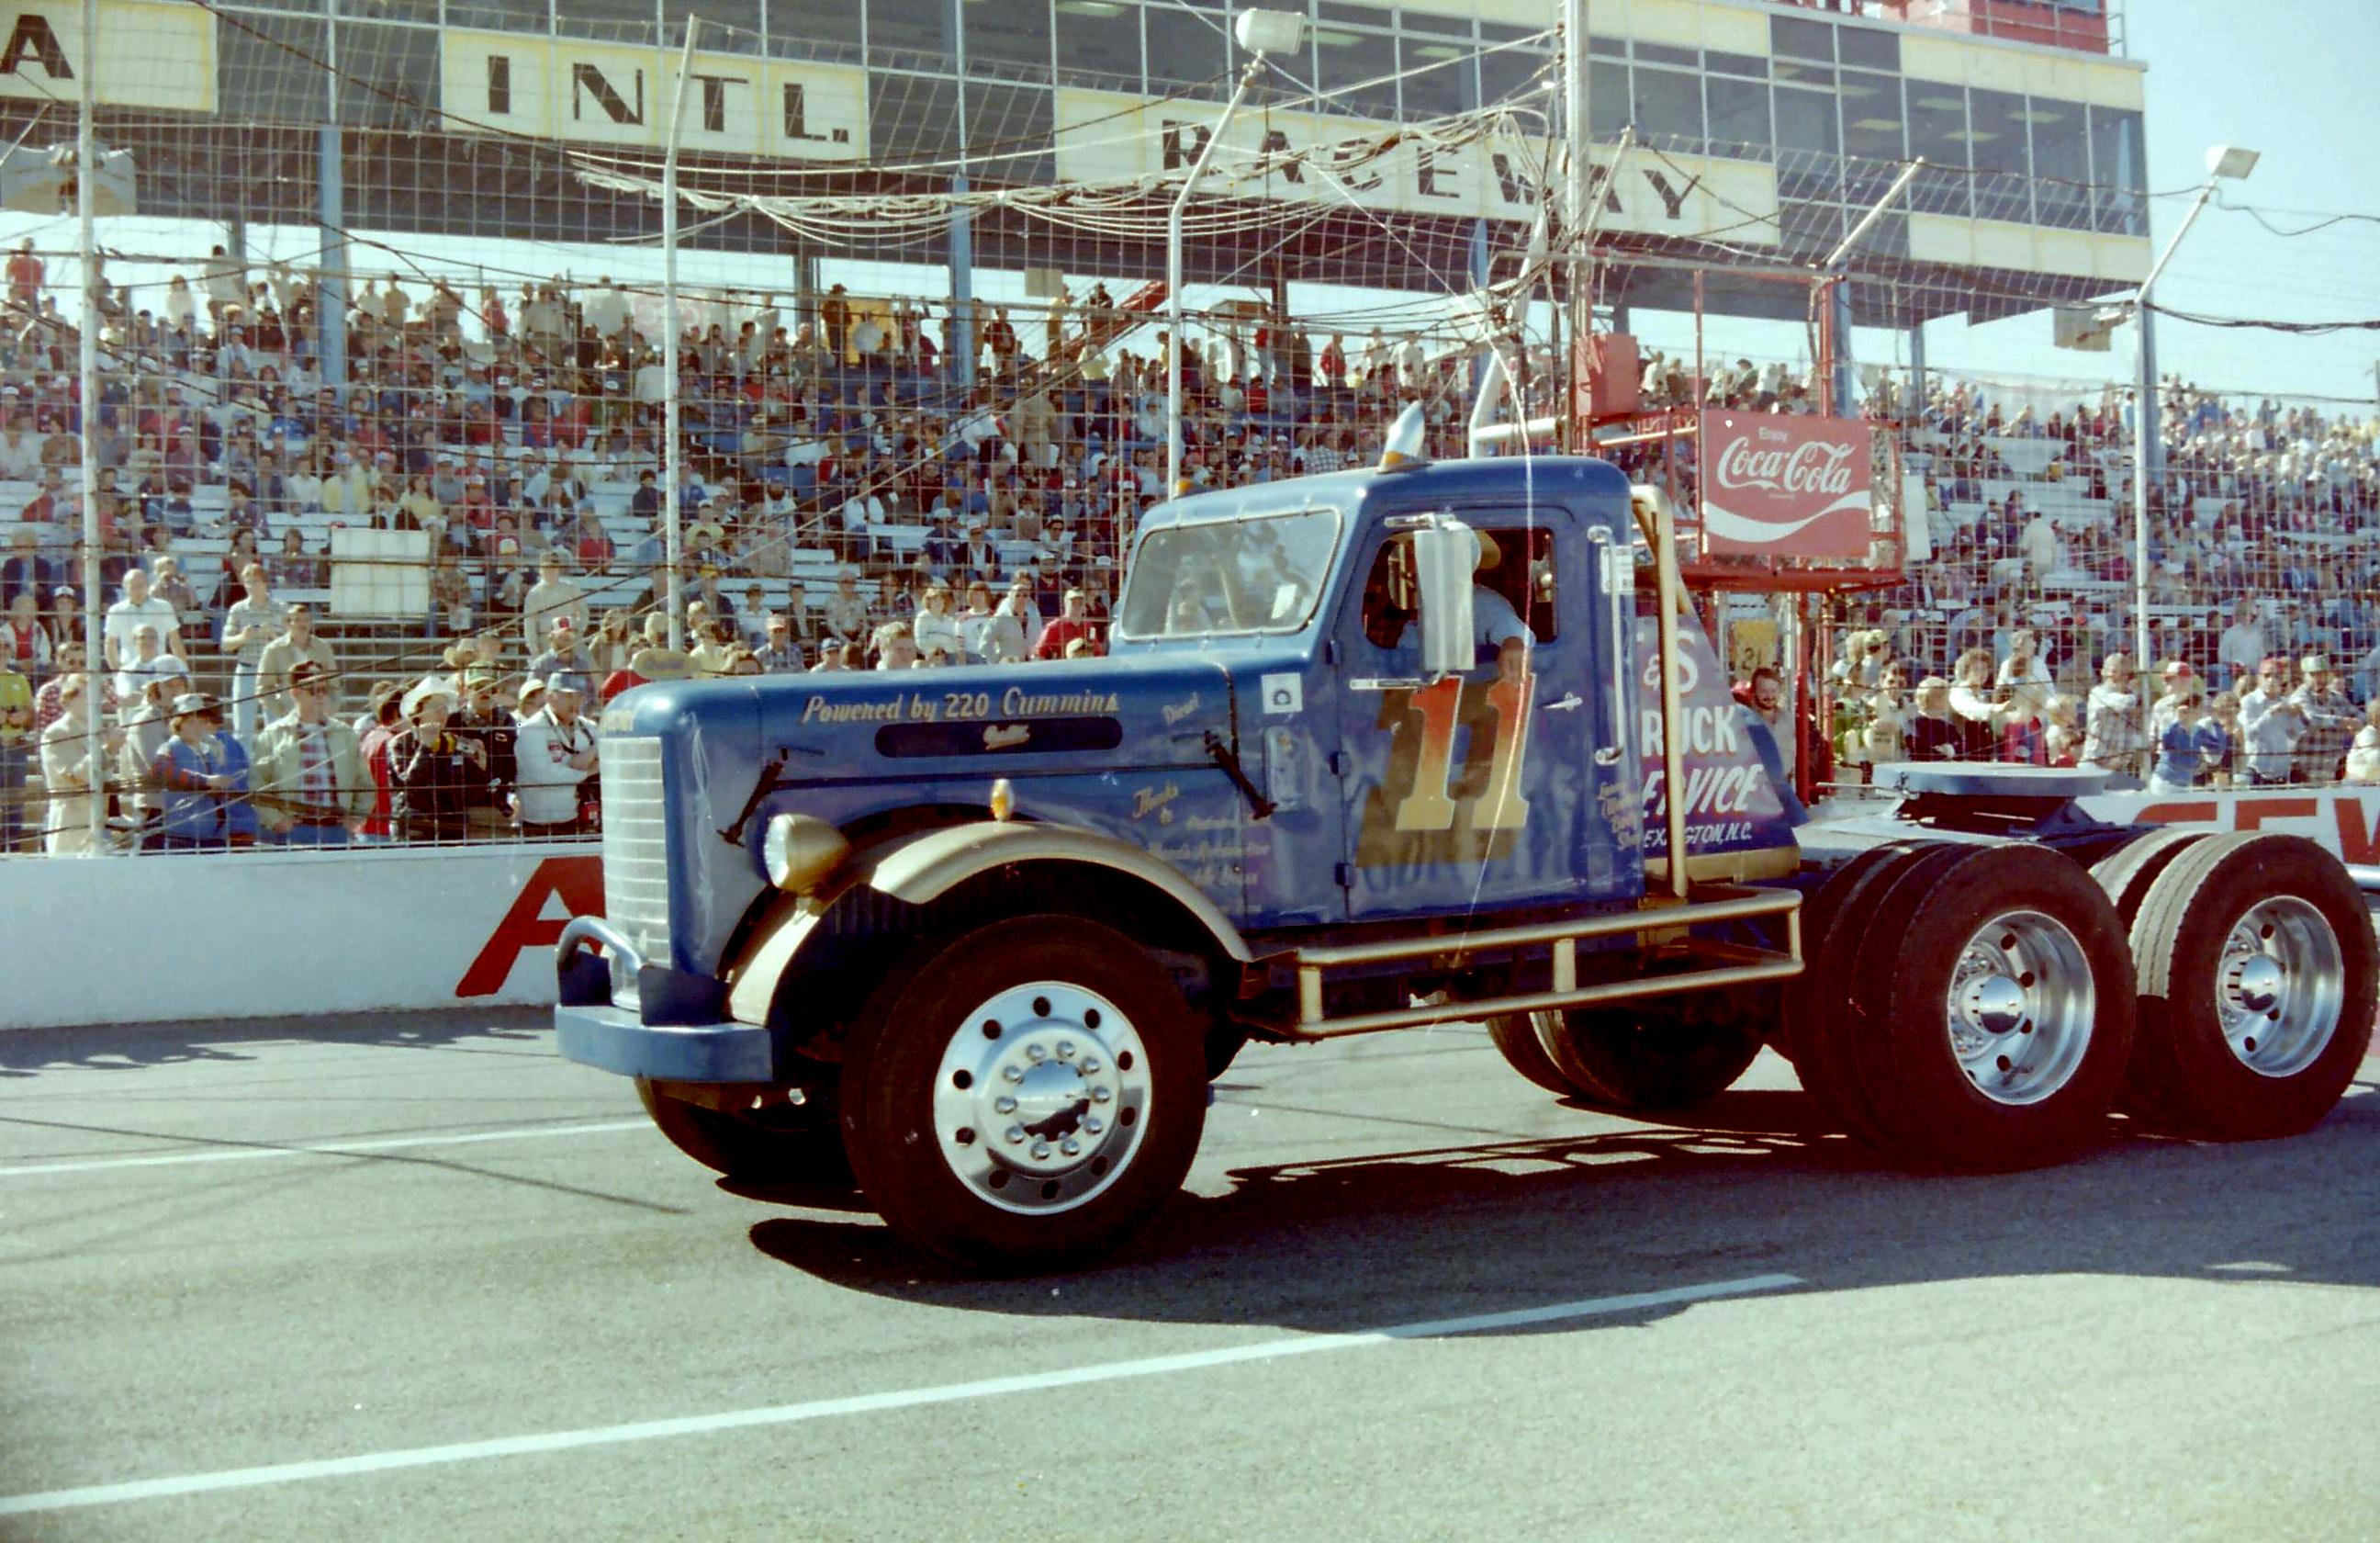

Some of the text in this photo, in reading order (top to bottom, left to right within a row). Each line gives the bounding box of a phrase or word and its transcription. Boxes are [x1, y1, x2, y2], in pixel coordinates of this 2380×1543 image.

[1717, 436, 1856, 493] Coca-Cola
[801, 687, 1120, 724] Powered by 220 Cummins
[1395, 673, 1537, 830] 11
